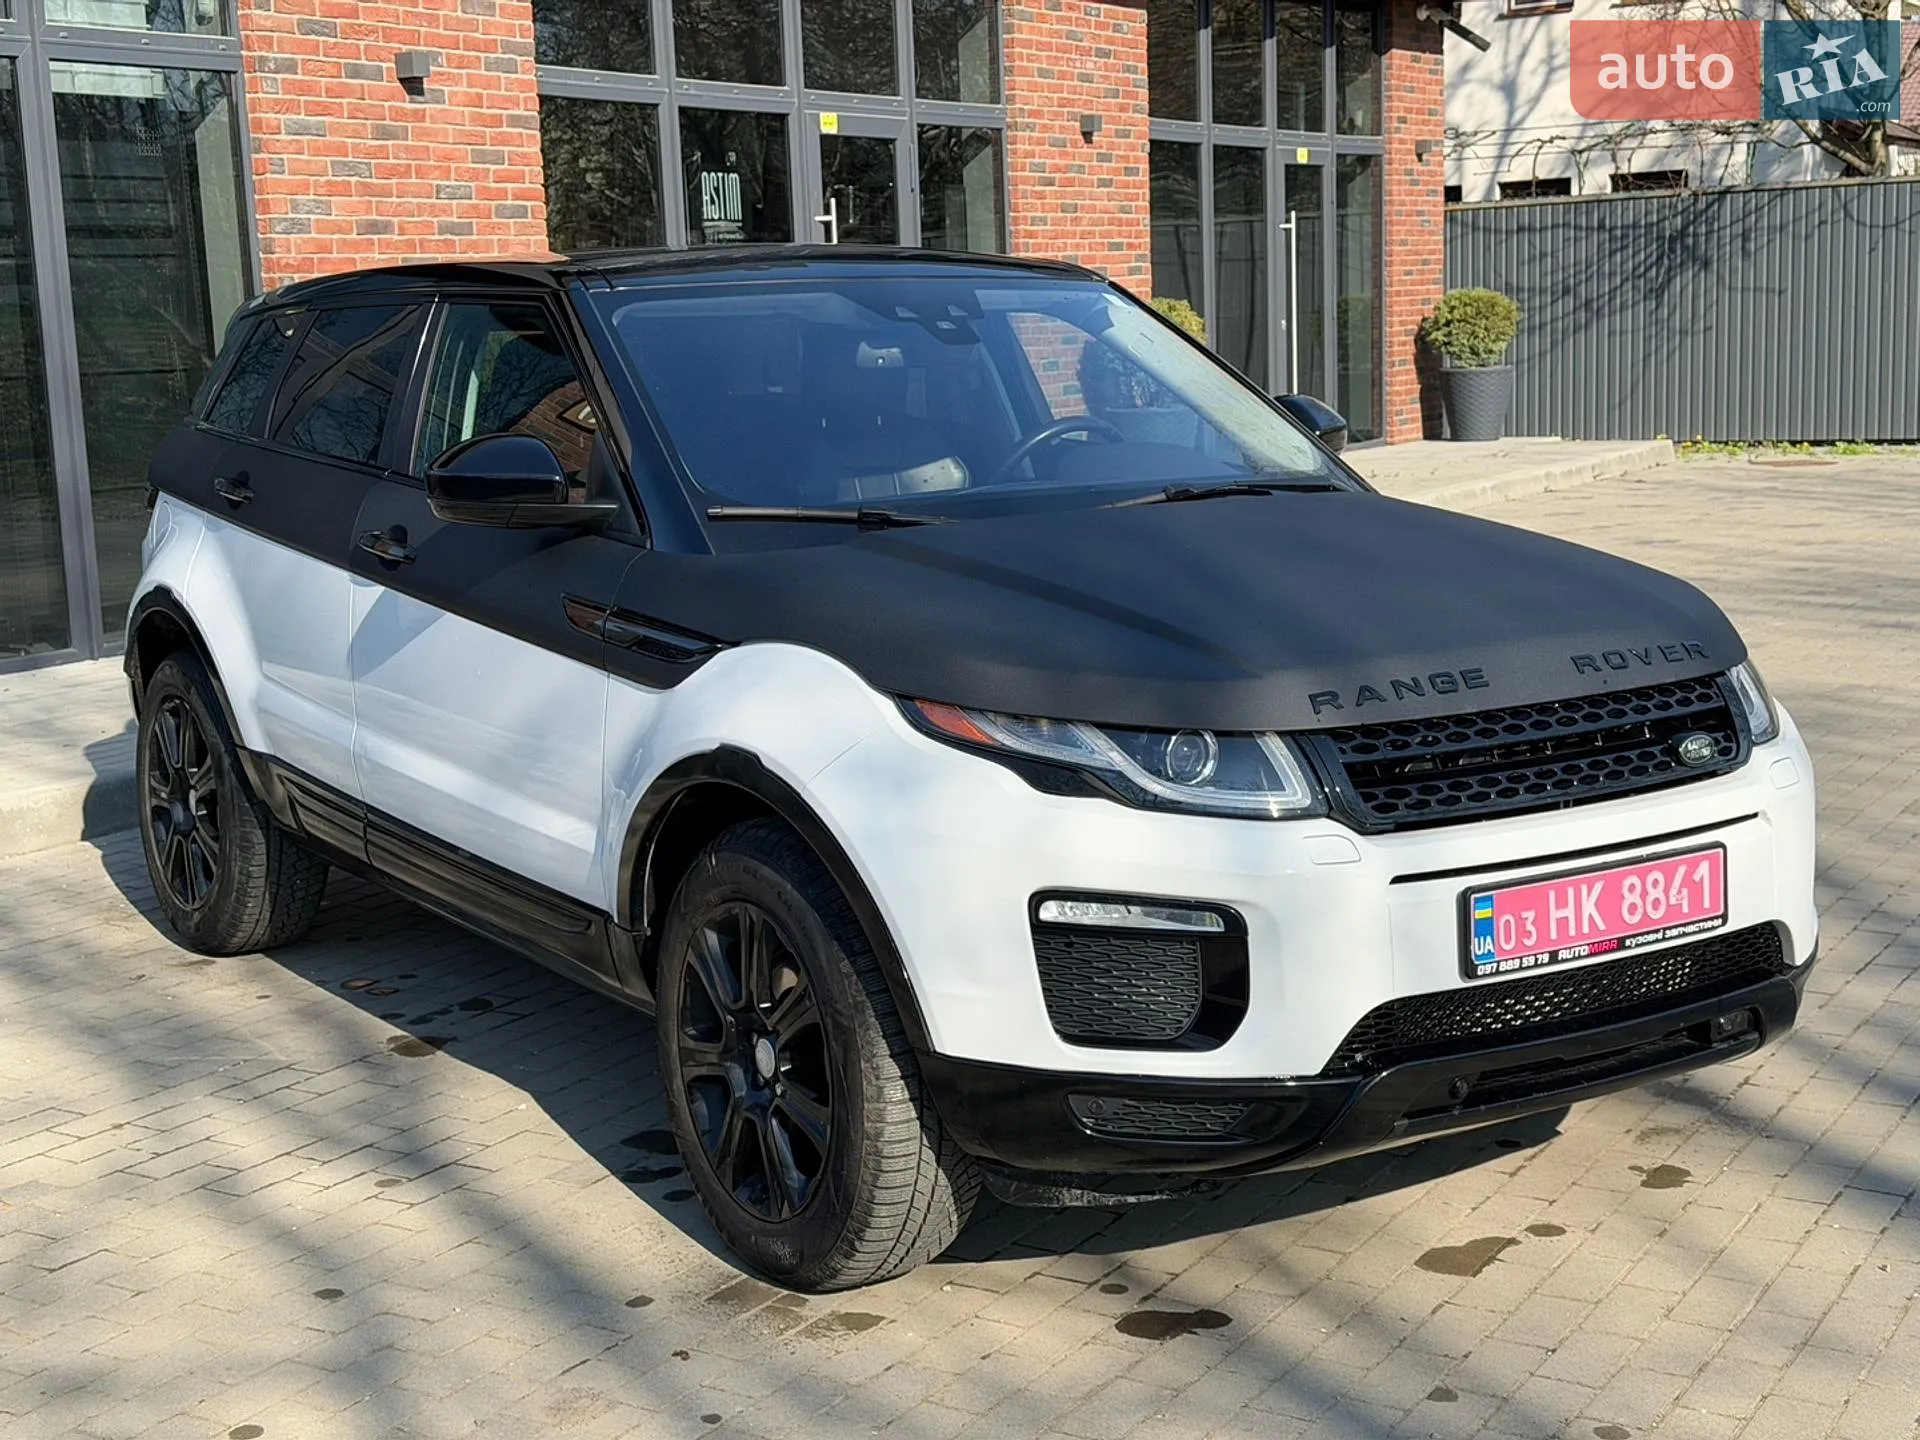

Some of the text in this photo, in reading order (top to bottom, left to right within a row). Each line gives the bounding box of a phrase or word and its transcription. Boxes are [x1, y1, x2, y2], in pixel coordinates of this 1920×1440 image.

[701, 171, 742, 220] ASTIM
[1308, 639, 1710, 716] RANGE ROVER
[1499, 909, 1537, 951] 03
[1621, 860, 1711, 925] 8841
[1474, 935, 1494, 955] UA
